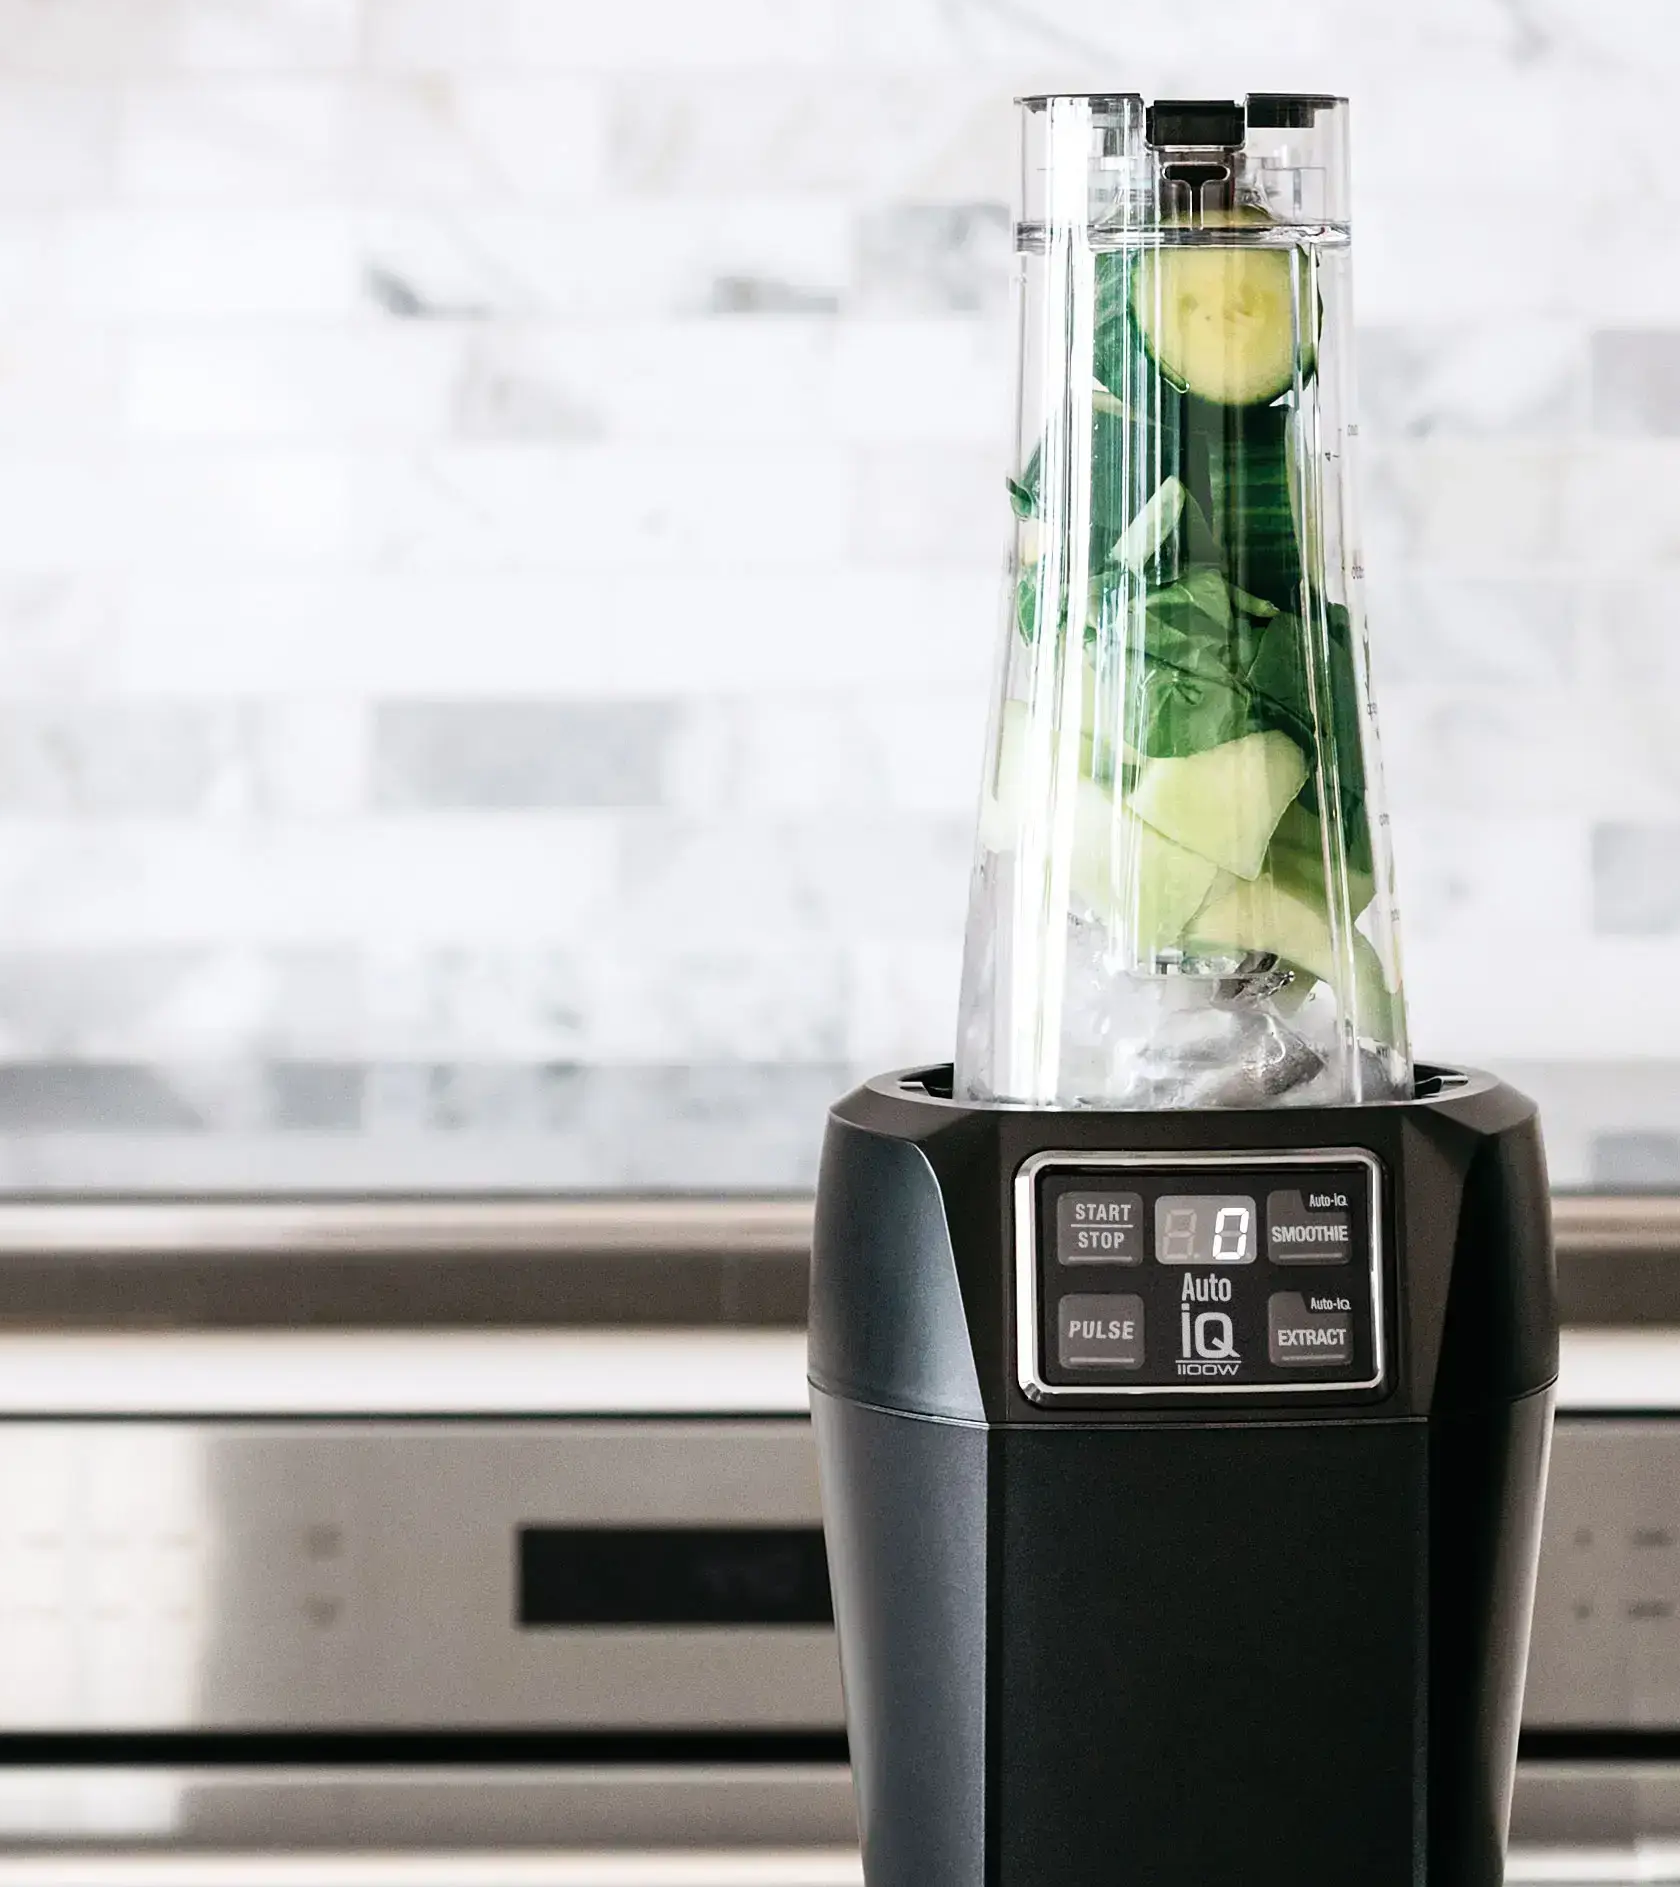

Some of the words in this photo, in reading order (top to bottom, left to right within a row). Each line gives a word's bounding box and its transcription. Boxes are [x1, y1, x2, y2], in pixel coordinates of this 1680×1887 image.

[1075, 1203, 1131, 1221] START
[1077, 1231, 1125, 1248] STOP
[1212, 1207, 1250, 1260] 0
[1271, 1224, 1349, 1242] SMOOTHIE
[1181, 1272, 1232, 1302] Auto
[1068, 1320, 1134, 1340] PULSE
[1277, 1328, 1347, 1347] EXTRACT
